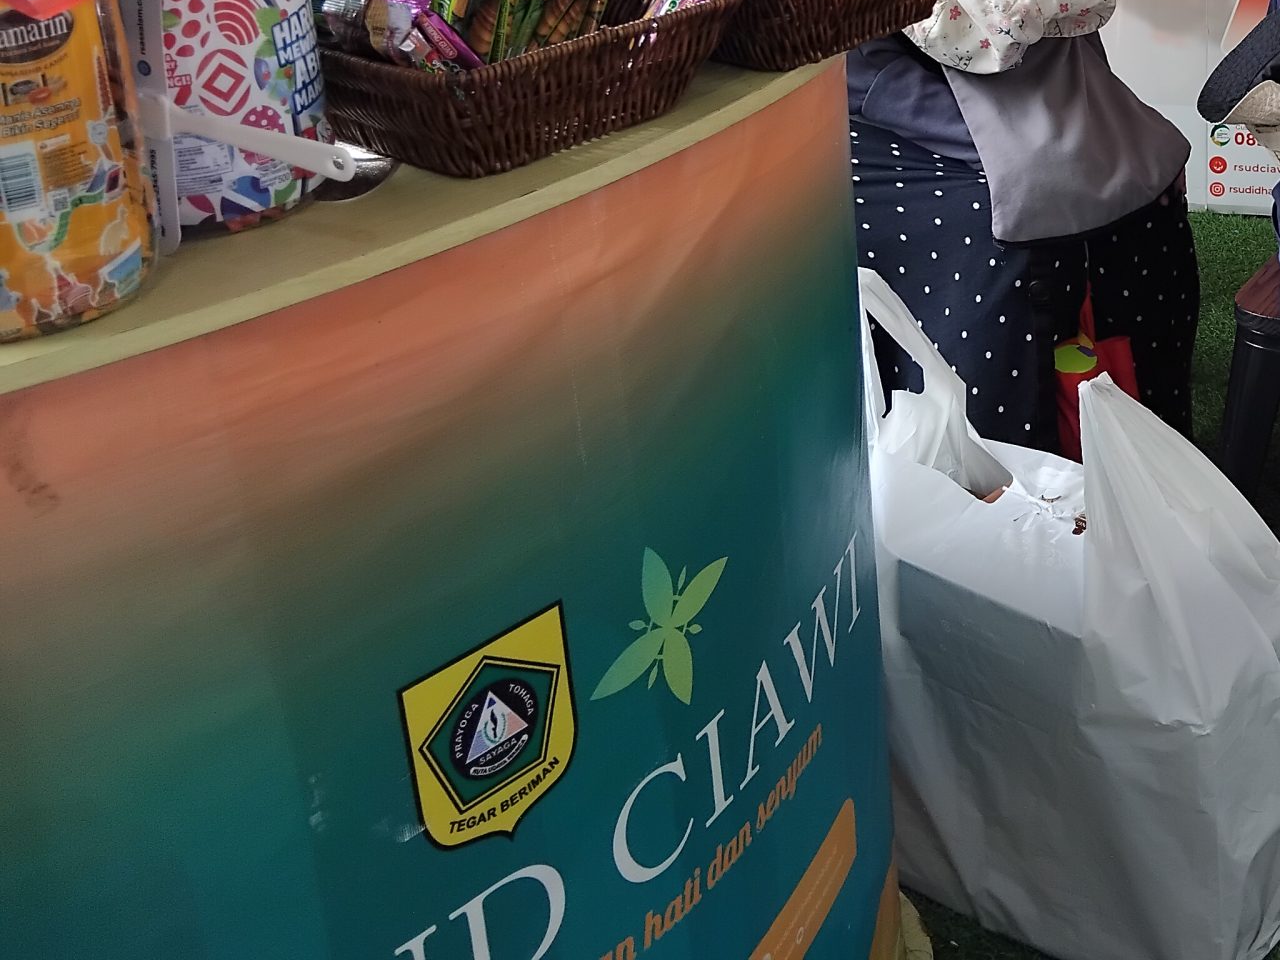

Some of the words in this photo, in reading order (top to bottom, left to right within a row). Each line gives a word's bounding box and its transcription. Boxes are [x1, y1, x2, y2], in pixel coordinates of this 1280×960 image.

[456, 703, 478, 759] PRAYOGA
[509, 683, 535, 716] TOHAGA
[613, 531, 861, 883] CIAWI
[479, 737, 517, 765] SAYAGA
[449, 807, 497, 834] TEGAR
[500, 756, 560, 814] BERIMAN
[643, 867, 702, 951] hati
[707, 821, 752, 890] dan
[756, 724, 823, 833] senyum
